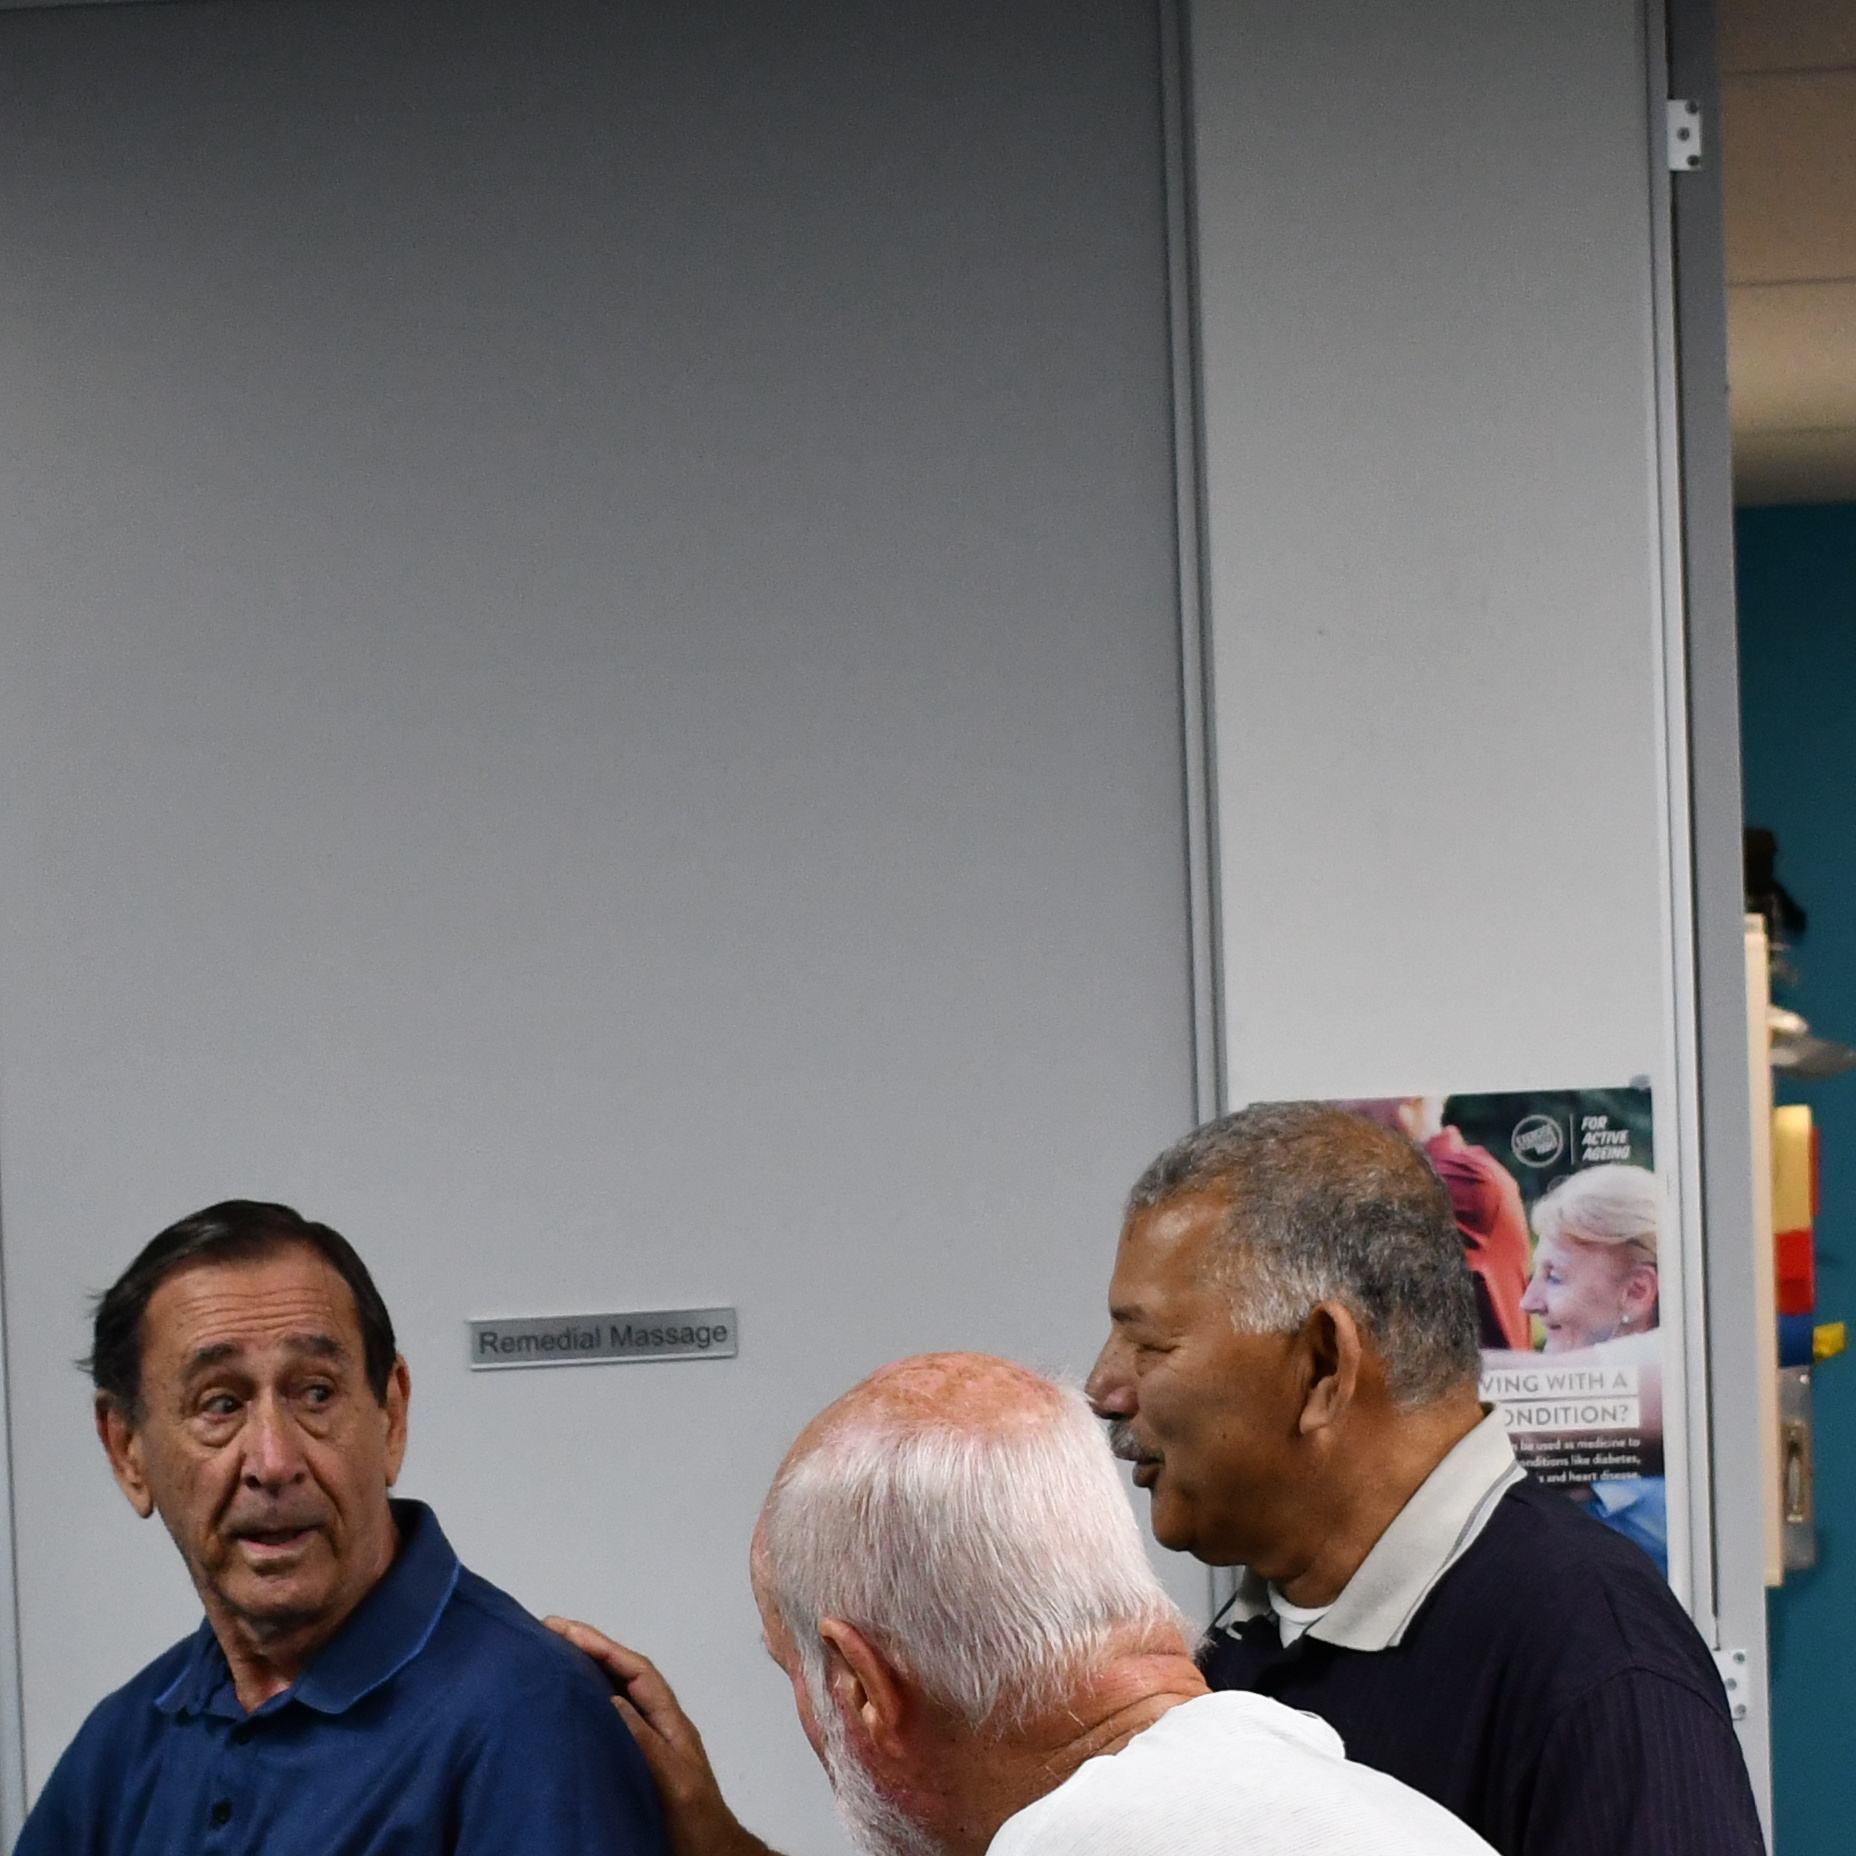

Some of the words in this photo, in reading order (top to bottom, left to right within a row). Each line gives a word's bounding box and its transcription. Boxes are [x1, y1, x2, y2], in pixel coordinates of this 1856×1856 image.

[1581, 1115, 1608, 1130] FOR
[1582, 1130, 1629, 1145] ACTIVE
[1582, 1145, 1631, 1160] AGEING
[479, 1326, 601, 1354] Remedial
[610, 1323, 728, 1349] Massage
[1480, 1375, 1538, 1393] VING
[1546, 1373, 1604, 1391] WITH
[1612, 1372, 1628, 1389] A
[1536, 1438, 1560, 1450] used
[1577, 1437, 1625, 1449] medicine
[1629, 1437, 1640, 1447] to
[1520, 1456, 1568, 1468] onditions
[1571, 1455, 1589, 1466] like
[1546, 1472, 1565, 1483] and
[1568, 1471, 1597, 1482] heart
